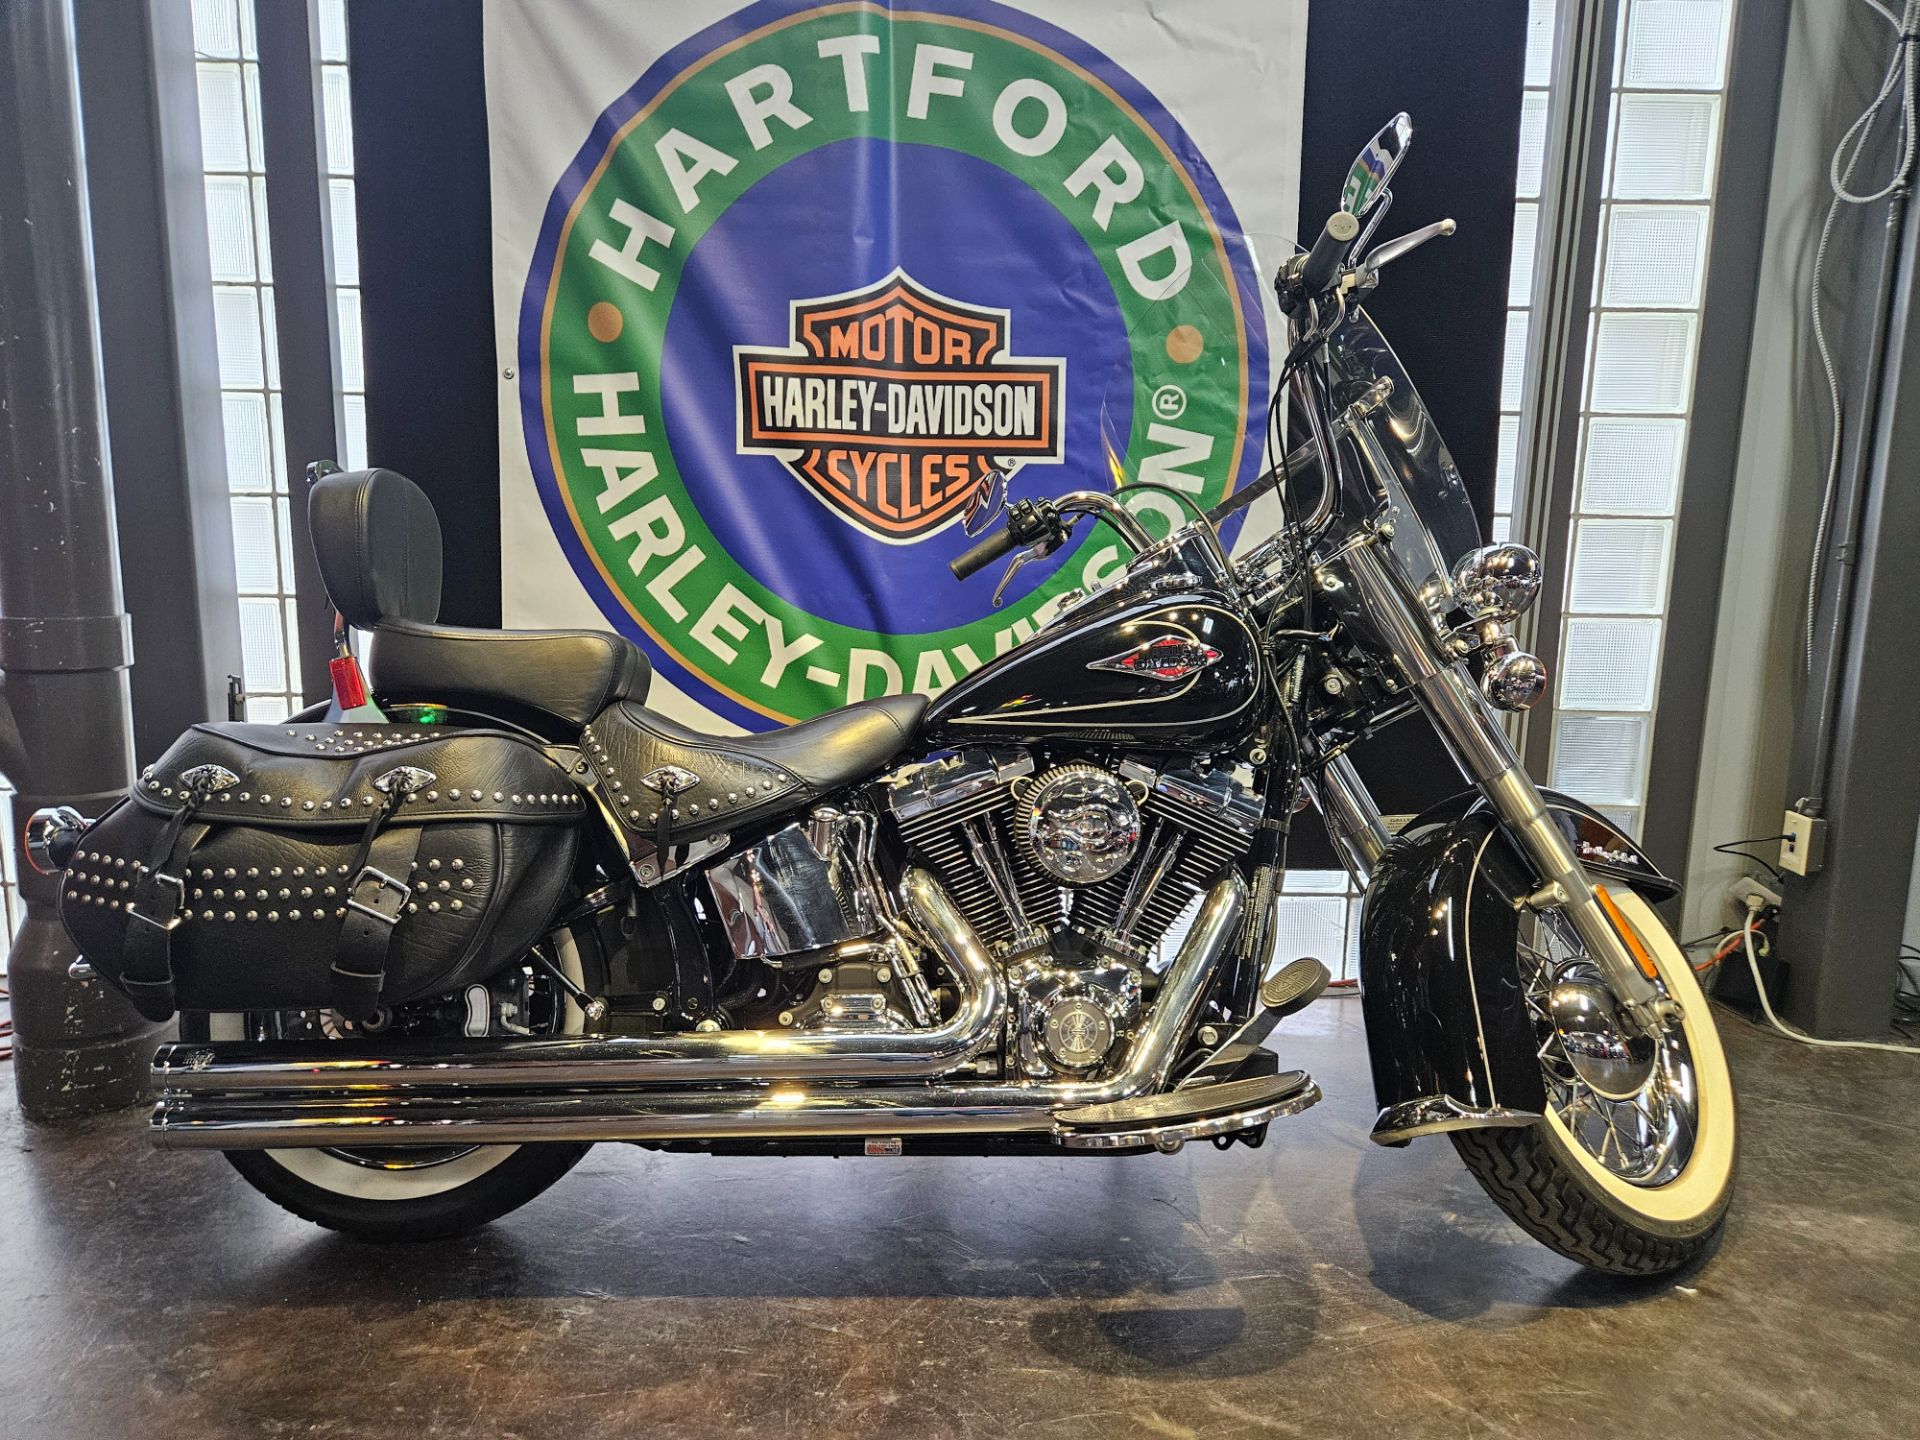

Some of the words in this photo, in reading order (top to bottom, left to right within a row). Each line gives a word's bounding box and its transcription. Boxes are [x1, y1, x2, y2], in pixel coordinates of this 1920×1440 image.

[588, 34, 1192, 301] HARTFORD
[830, 303, 971, 365] MOTOR
[762, 375, 1036, 437] HARLEY-DAVIDSON
[827, 449, 970, 519] CYCLES
